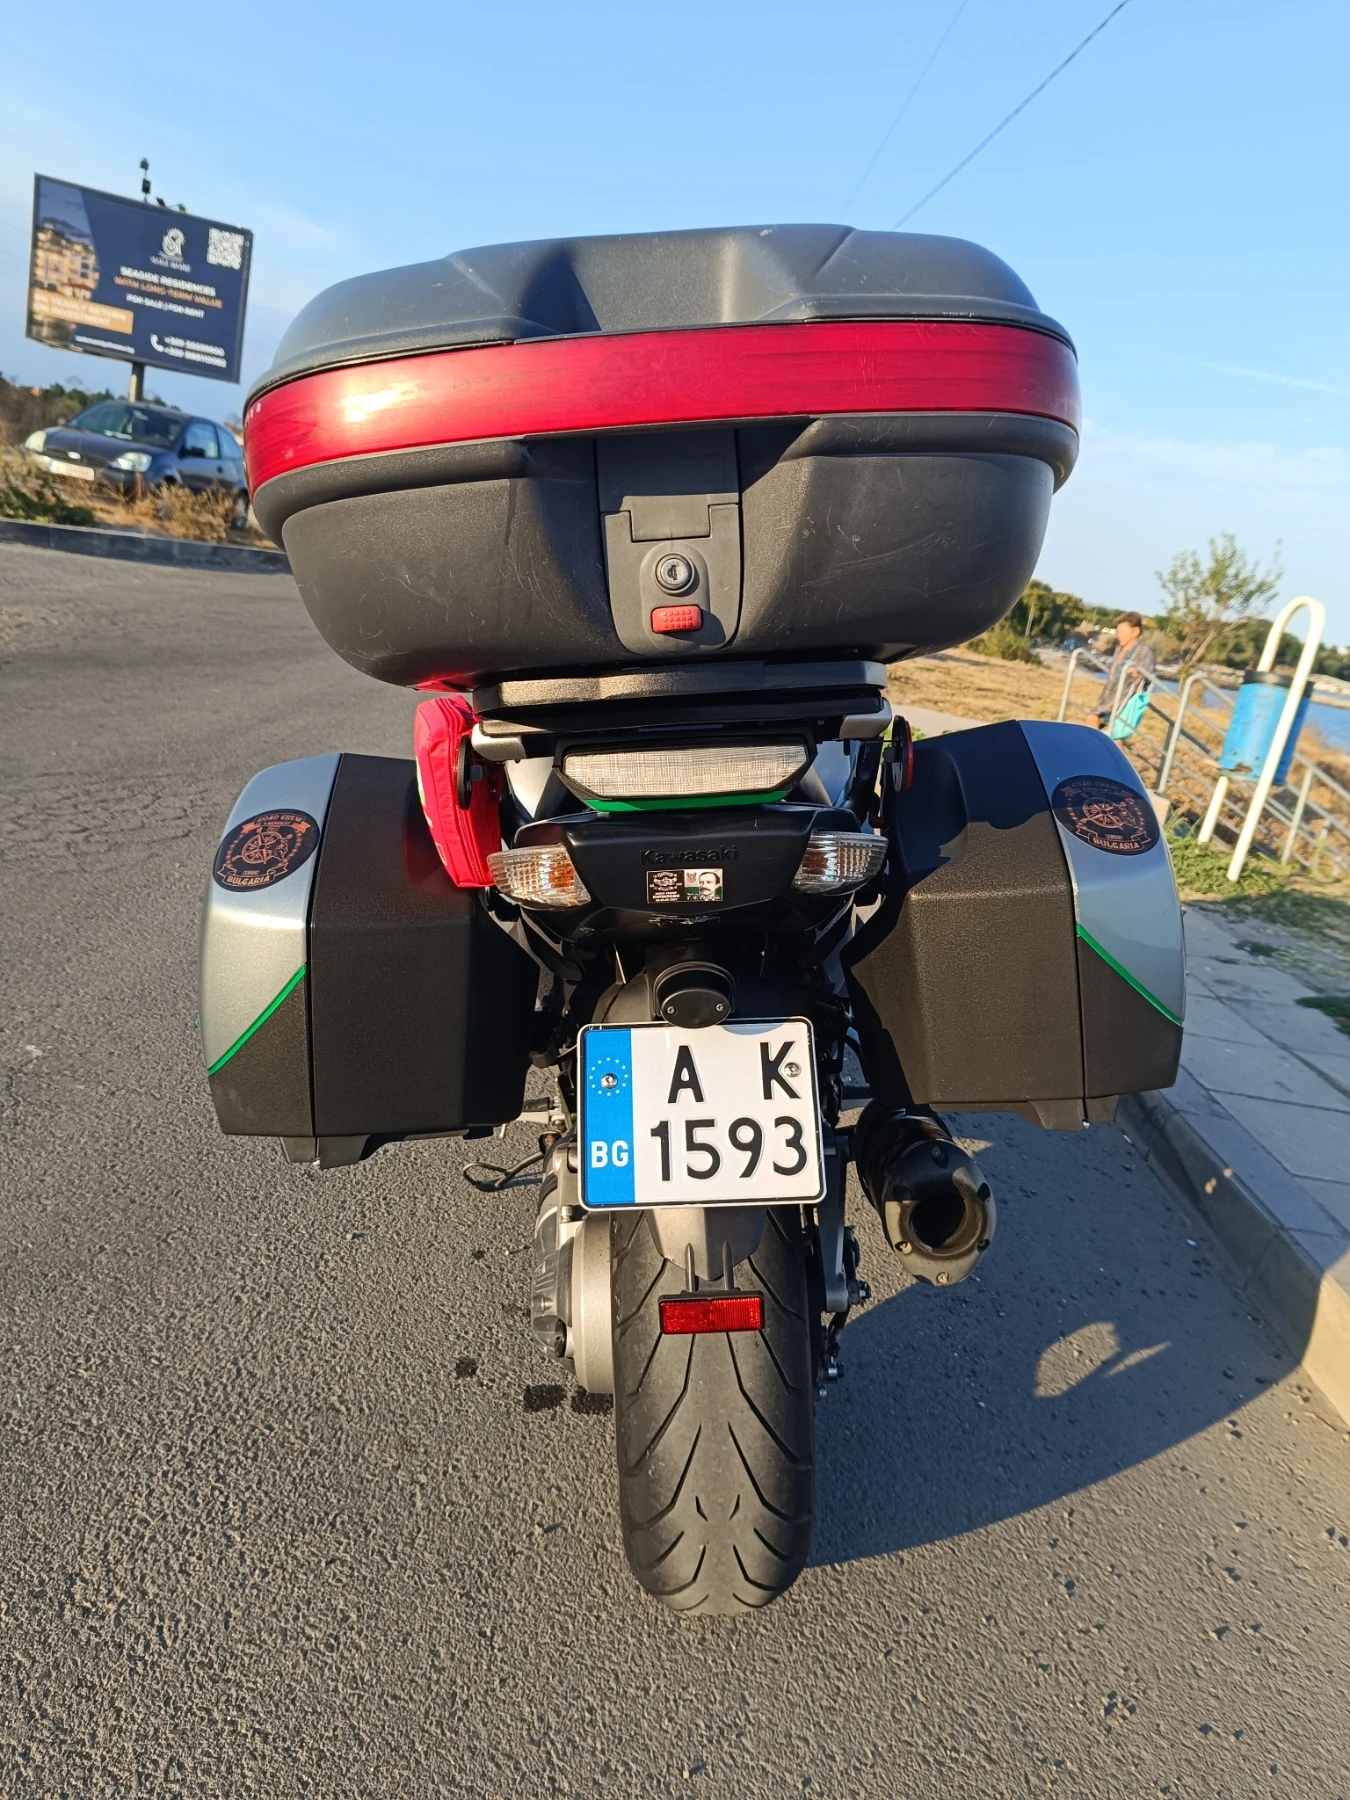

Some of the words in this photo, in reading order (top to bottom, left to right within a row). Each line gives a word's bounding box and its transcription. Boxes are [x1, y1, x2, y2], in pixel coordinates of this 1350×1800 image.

[120, 265, 160, 284] SEASIDE
[160, 275, 216, 297] RESIDENCES
[257, 815, 280, 823] ROAD
[280, 814, 303, 822] CREW
[640, 845, 739, 865] Kawasaki
[1092, 838, 1140, 849] BULGARIA
[227, 875, 271, 885] BULGARIA
[667, 1045, 704, 1103] A
[760, 1041, 801, 1100] K
[591, 1140, 629, 1168] BG
[650, 1116, 807, 1181] 1593
